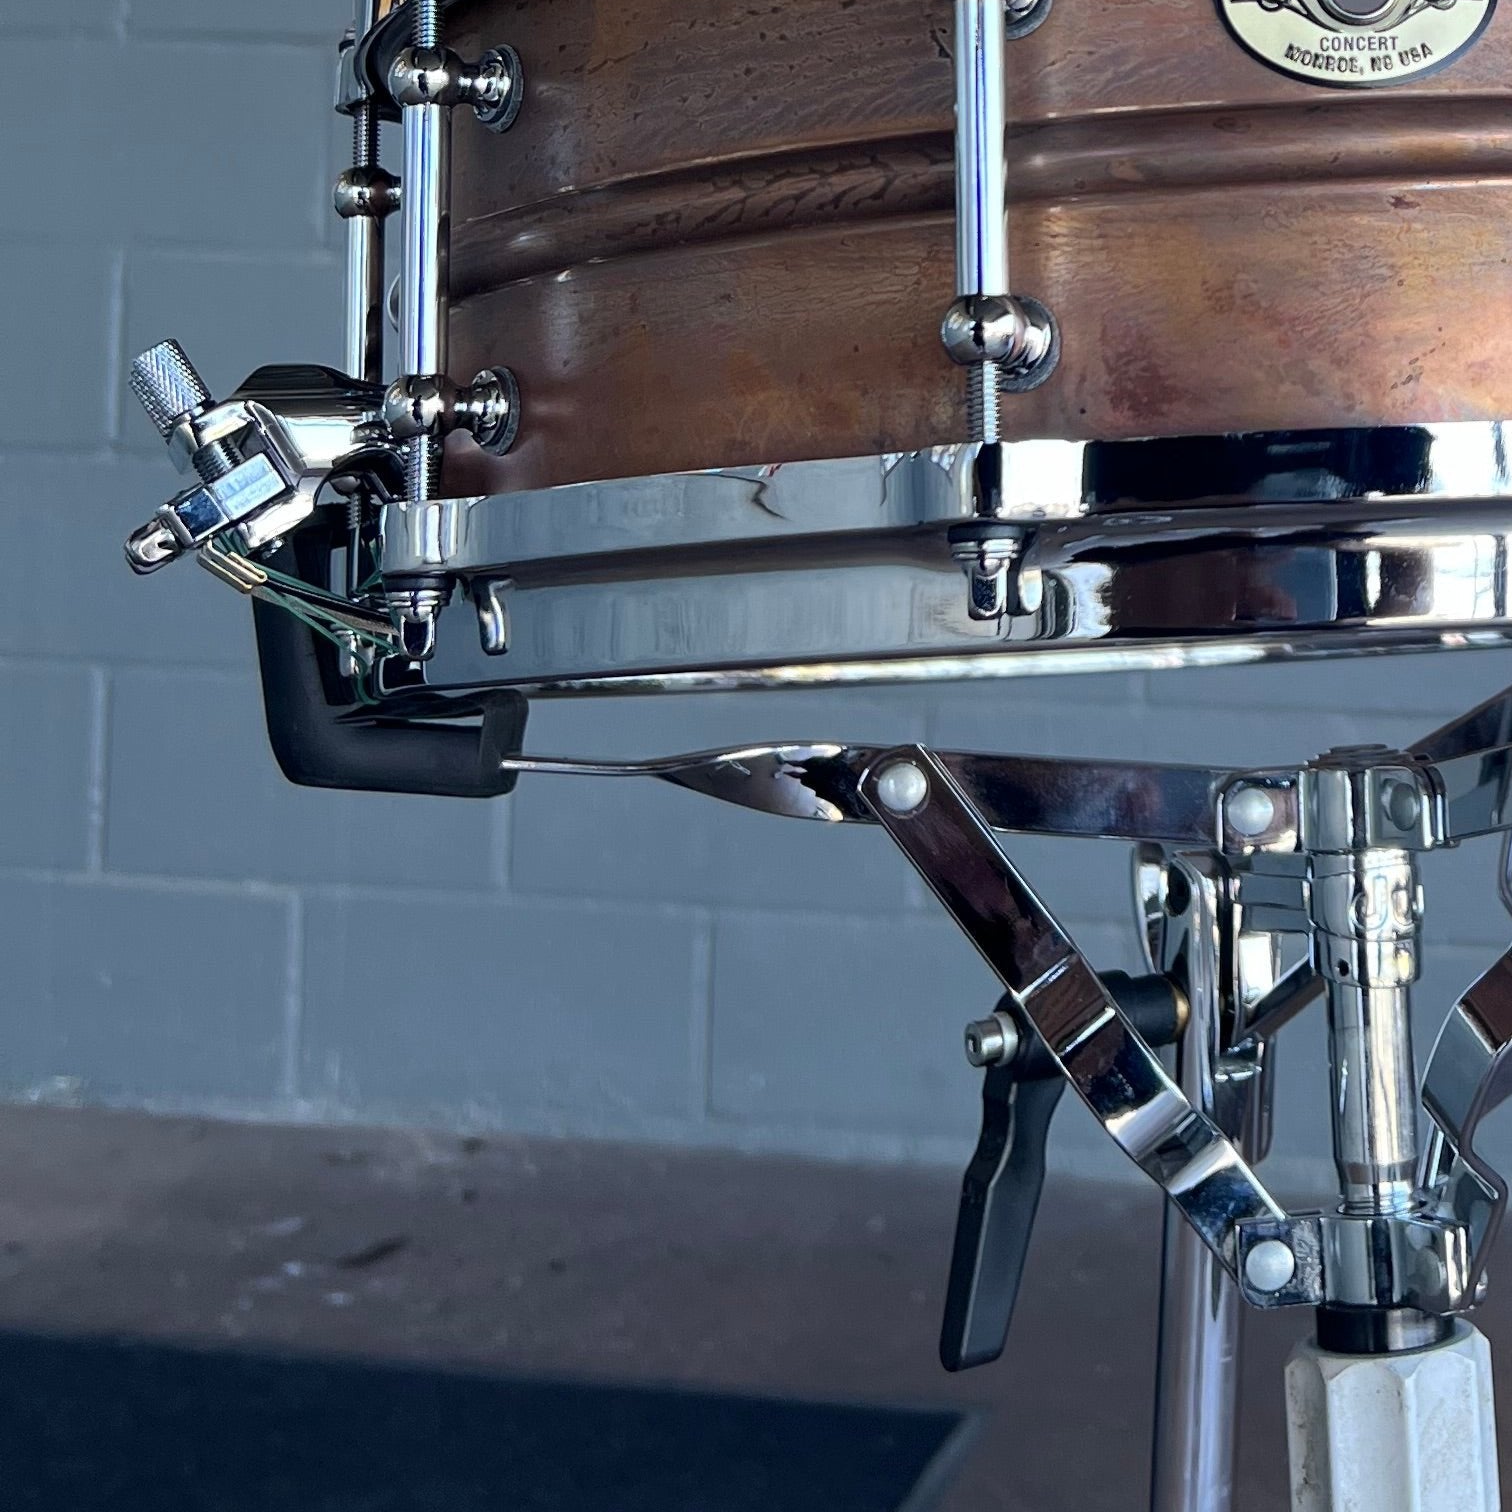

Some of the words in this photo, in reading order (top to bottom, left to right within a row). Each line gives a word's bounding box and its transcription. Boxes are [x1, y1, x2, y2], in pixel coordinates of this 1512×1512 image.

[1320, 36, 1399, 51] CONCERT
[1284, 43, 1364, 75] MONROE,
[1398, 42, 1433, 67] USA
